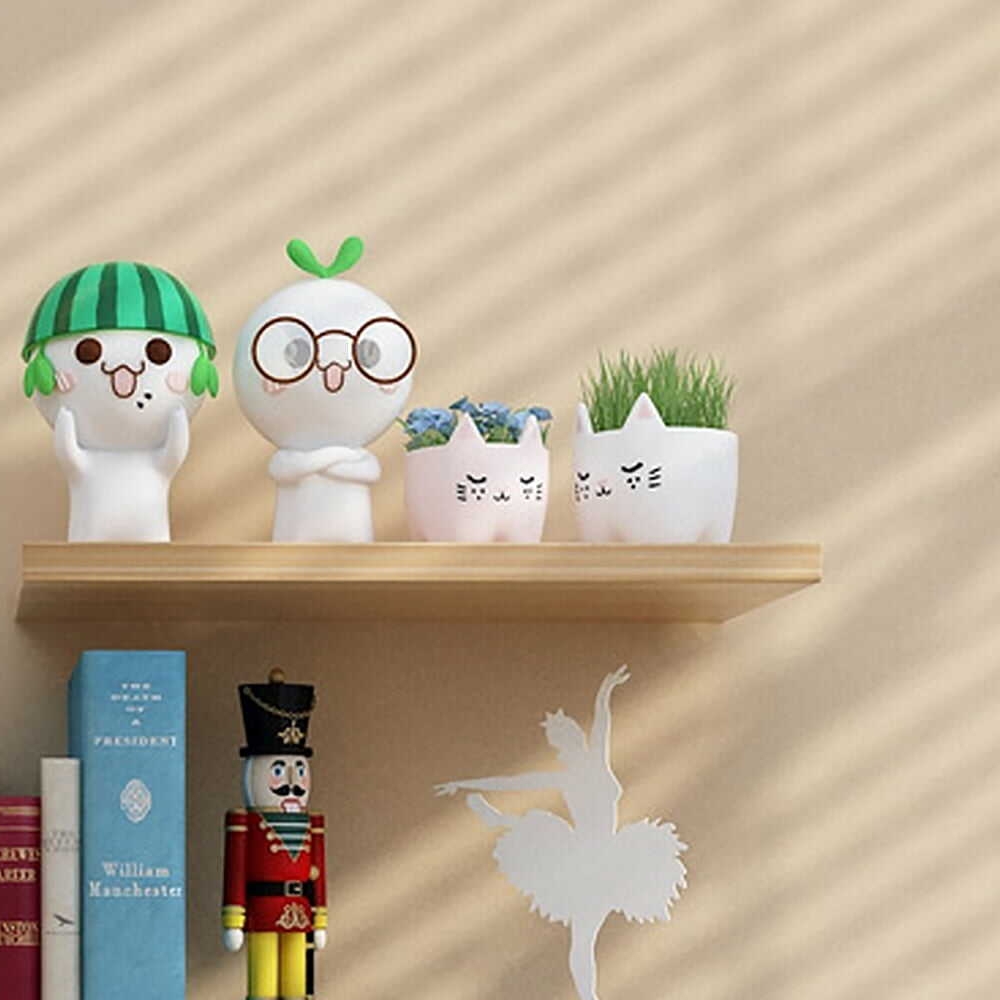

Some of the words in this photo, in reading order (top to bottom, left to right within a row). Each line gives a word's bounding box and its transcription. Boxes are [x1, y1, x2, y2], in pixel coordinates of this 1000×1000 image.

[94, 736, 176, 747] PRESIDENT
[102, 862, 170, 877] William
[89, 881, 183, 897] Manchester
